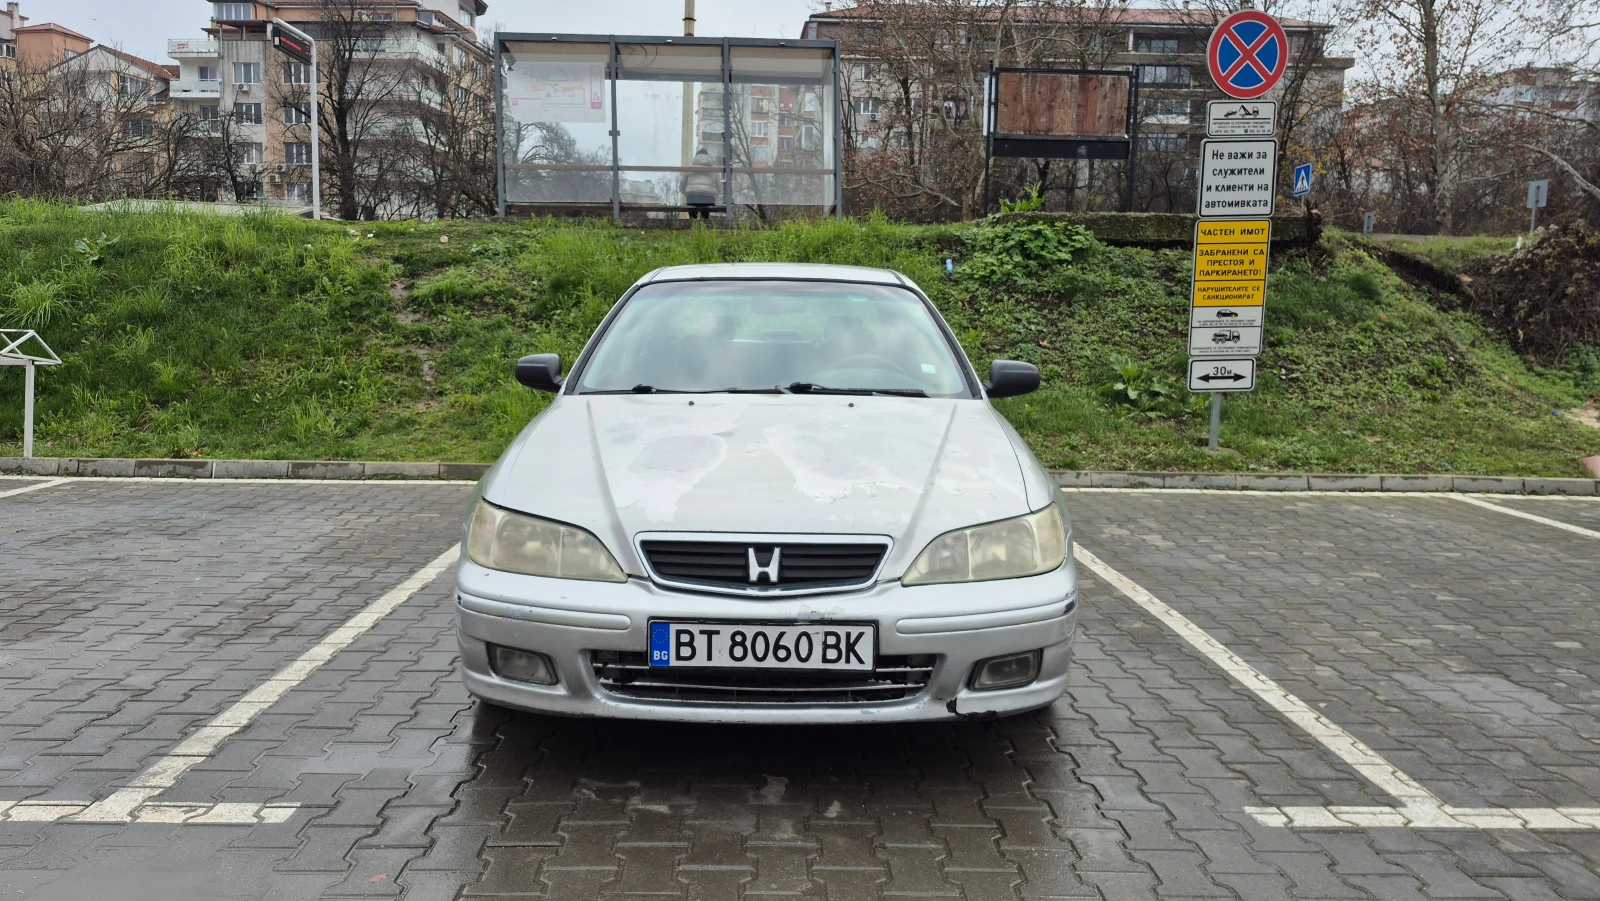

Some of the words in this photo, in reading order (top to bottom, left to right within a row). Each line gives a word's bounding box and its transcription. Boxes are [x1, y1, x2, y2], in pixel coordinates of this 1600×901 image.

[1212, 150, 1224, 160] Не
[1228, 152, 1253, 160] важи
[1256, 151, 1267, 159] за
[1212, 168, 1264, 178] служители
[1215, 184, 1254, 192] клиенти
[1258, 184, 1268, 192] на
[1204, 200, 1268, 208] автомивката
[675, 628, 720, 662] BT
[728, 630, 814, 663] 8060
[822, 630, 866, 664] BK
[653, 650, 668, 660] BG
